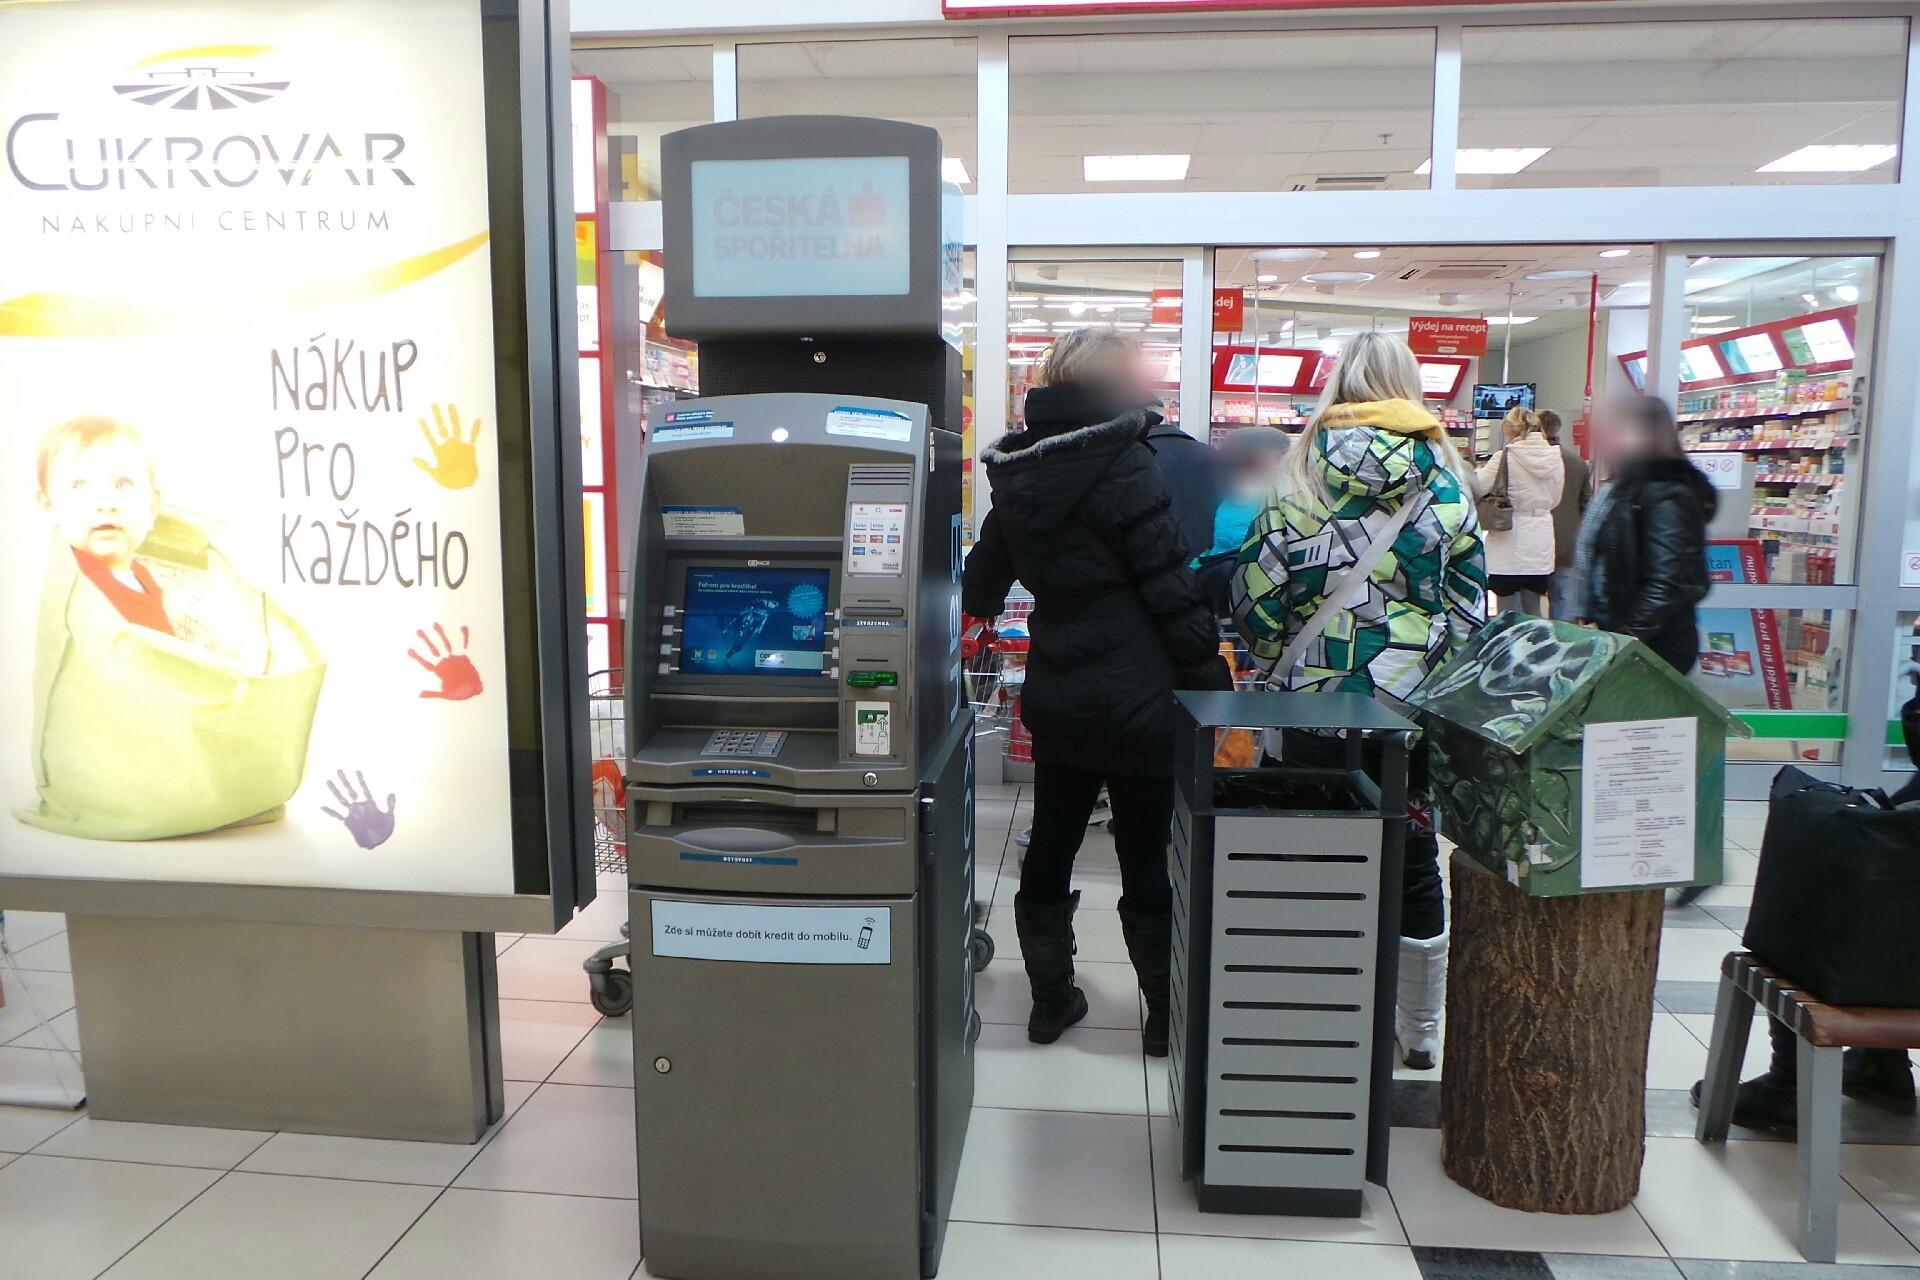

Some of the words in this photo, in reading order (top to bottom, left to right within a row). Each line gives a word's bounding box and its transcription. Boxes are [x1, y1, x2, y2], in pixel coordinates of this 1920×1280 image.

[6, 111, 416, 191] CUKROVAR
[217, 209, 391, 232] CENTRUM
[712, 185, 845, 228] ČESKÁ
[713, 228, 886, 261] SPOŘITELNA
[1411, 321, 1440, 333] Výdej
[1441, 323, 1454, 331] na
[1455, 325, 1487, 334] recept
[1745, 555, 1758, 584] odinu
[949, 513, 974, 1057] Bankomat
[664, 925, 683, 936] Zde
[684, 925, 694, 936] si
[696, 926, 733, 938] můžete
[764, 930, 794, 941] kredit
[797, 931, 810, 941] do
